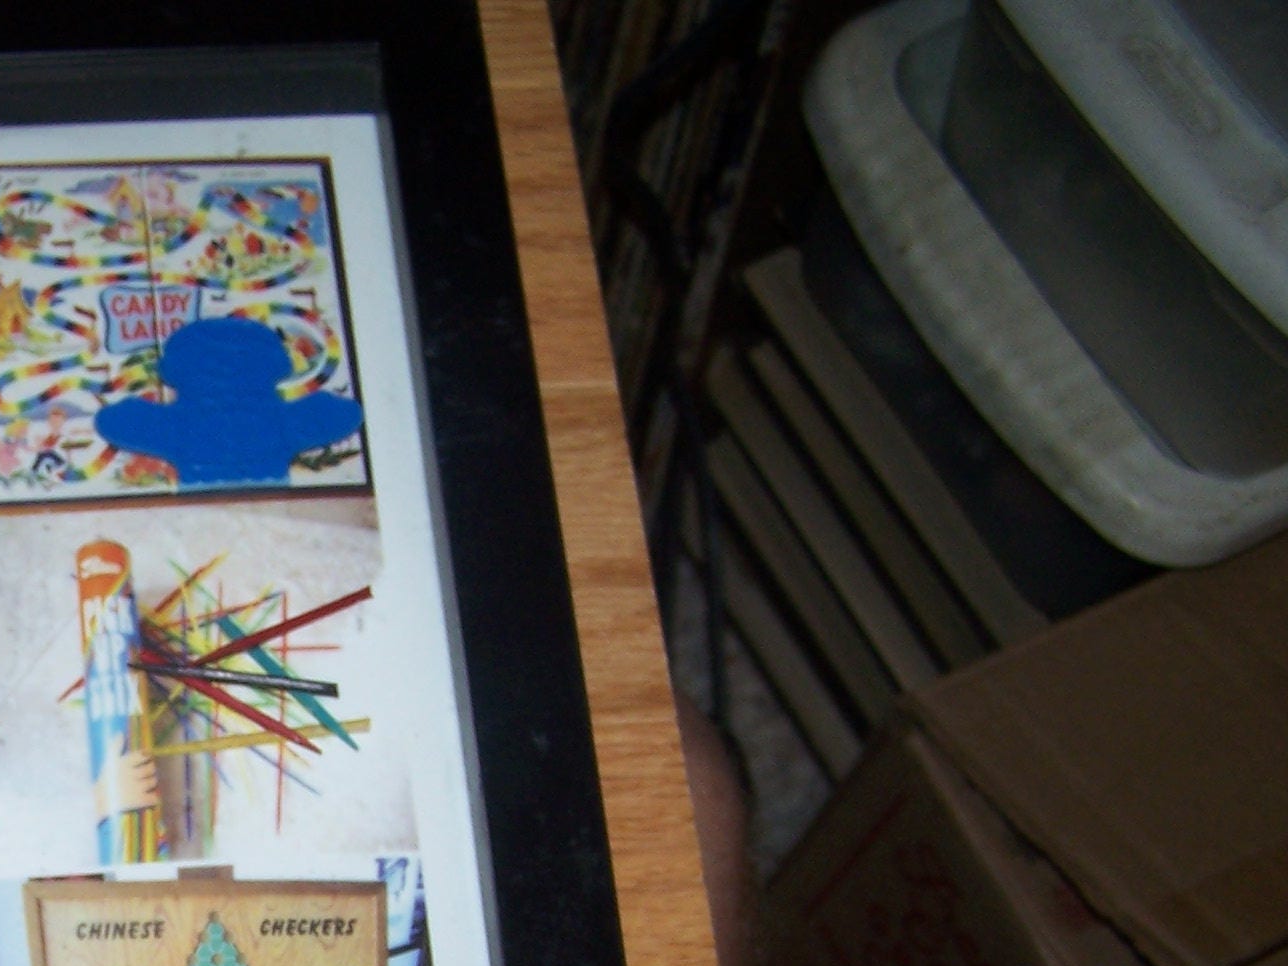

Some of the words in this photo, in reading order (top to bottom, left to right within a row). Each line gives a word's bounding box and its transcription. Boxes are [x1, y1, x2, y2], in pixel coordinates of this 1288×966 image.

[111, 293, 190, 317] CANDY
[76, 919, 166, 941] CHINESE
[259, 917, 358, 938] CHECKERS
